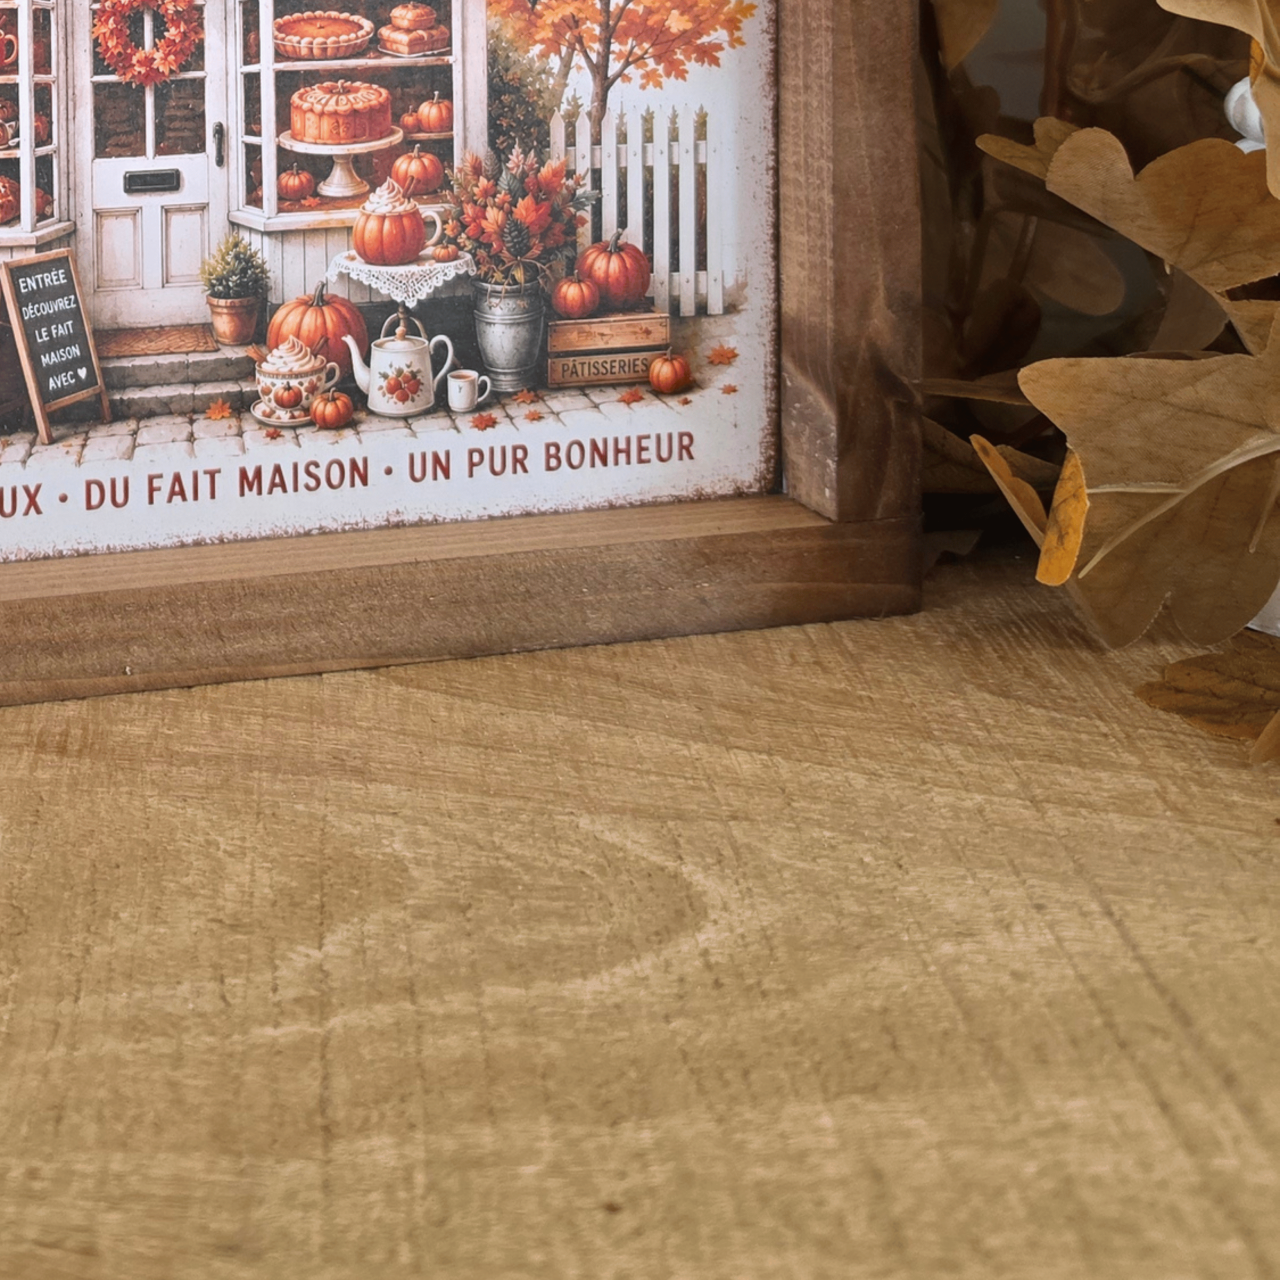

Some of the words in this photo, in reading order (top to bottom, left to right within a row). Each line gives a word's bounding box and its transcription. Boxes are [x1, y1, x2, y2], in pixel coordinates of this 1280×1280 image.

[18, 268, 68, 293] ENTRÉE
[22, 294, 77, 320] DÉCOUVREZ
[35, 327, 50, 343] LE
[51, 320, 74, 338] FAIT
[40, 343, 81, 367] MAISON
[561, 357, 649, 379] PÂTISSERIES
[48, 371, 76, 391] AVEC
[85, 475, 130, 511] DU
[147, 468, 222, 505] FAIT
[238, 456, 370, 498] MAISON
[408, 449, 452, 484] UN
[467, 442, 530, 478] PUR
[544, 431, 696, 473] BONHEUR
